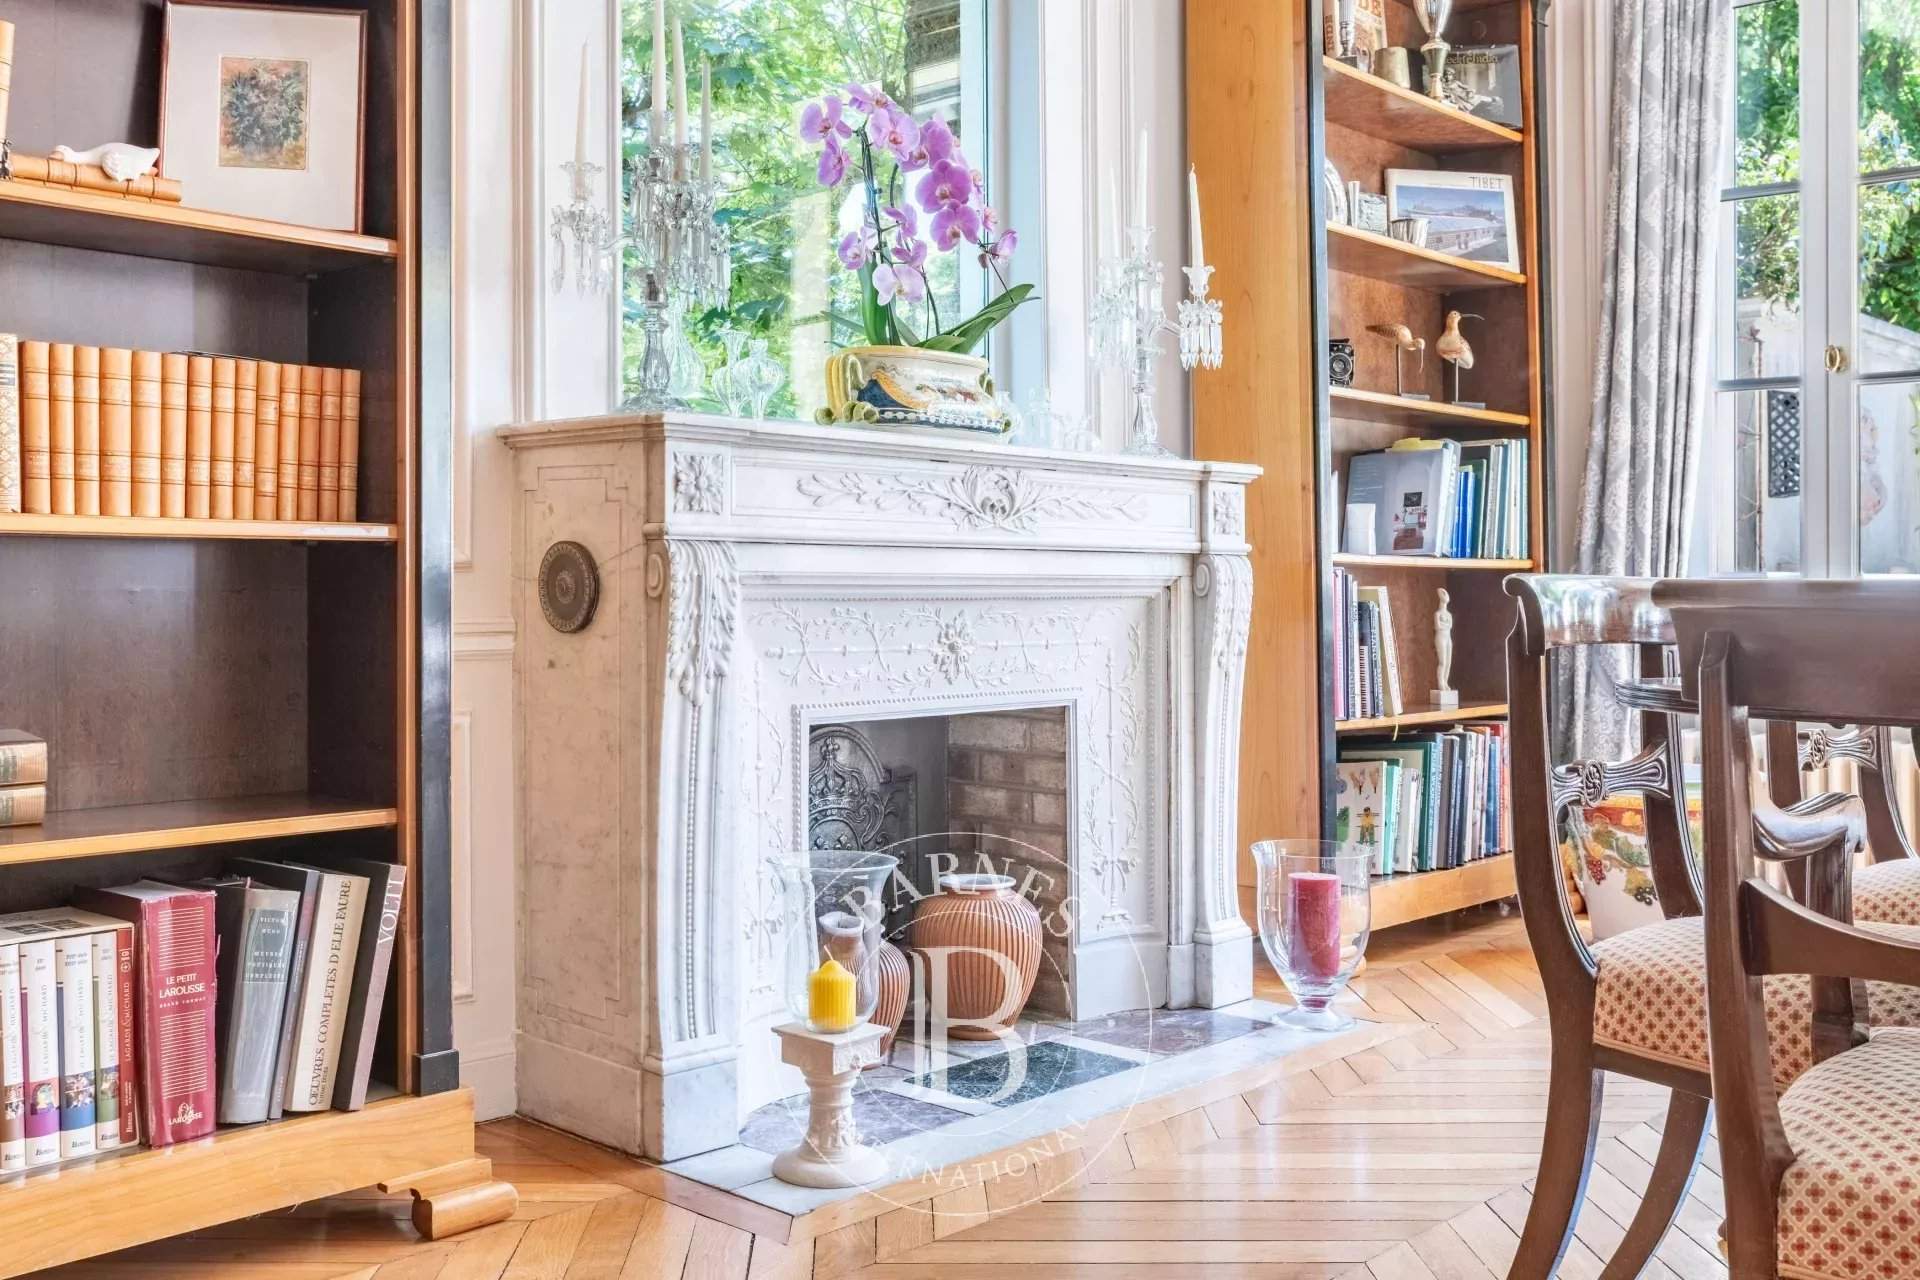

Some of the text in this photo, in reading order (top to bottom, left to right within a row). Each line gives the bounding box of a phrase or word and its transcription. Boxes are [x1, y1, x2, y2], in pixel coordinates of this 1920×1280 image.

[1468, 175, 1505, 190] TIBET
[336, 880, 352, 921] FAURE
[377, 880, 404, 945] VOLTI
[166, 972, 198, 985] LE PETIT
[159, 982, 206, 999] LAROUSSE
